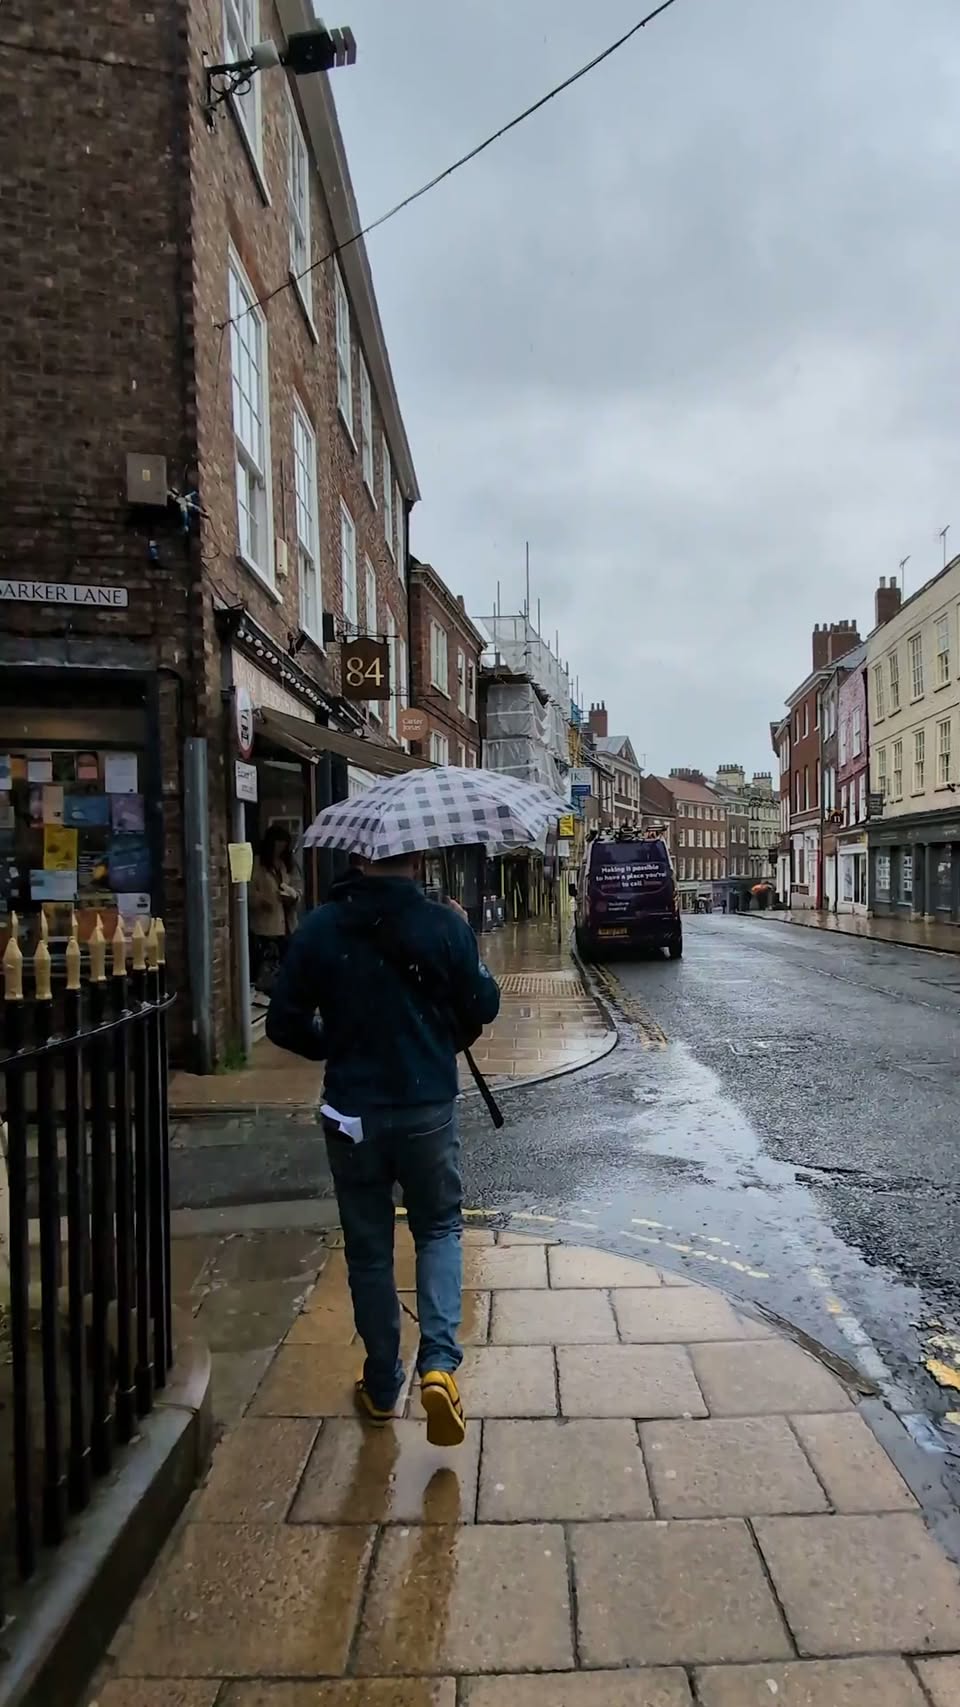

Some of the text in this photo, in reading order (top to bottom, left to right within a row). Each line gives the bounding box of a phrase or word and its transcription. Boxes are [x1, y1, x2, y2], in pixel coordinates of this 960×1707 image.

[0, 584, 121, 604] ARKER LANE
[347, 657, 384, 687] 84
